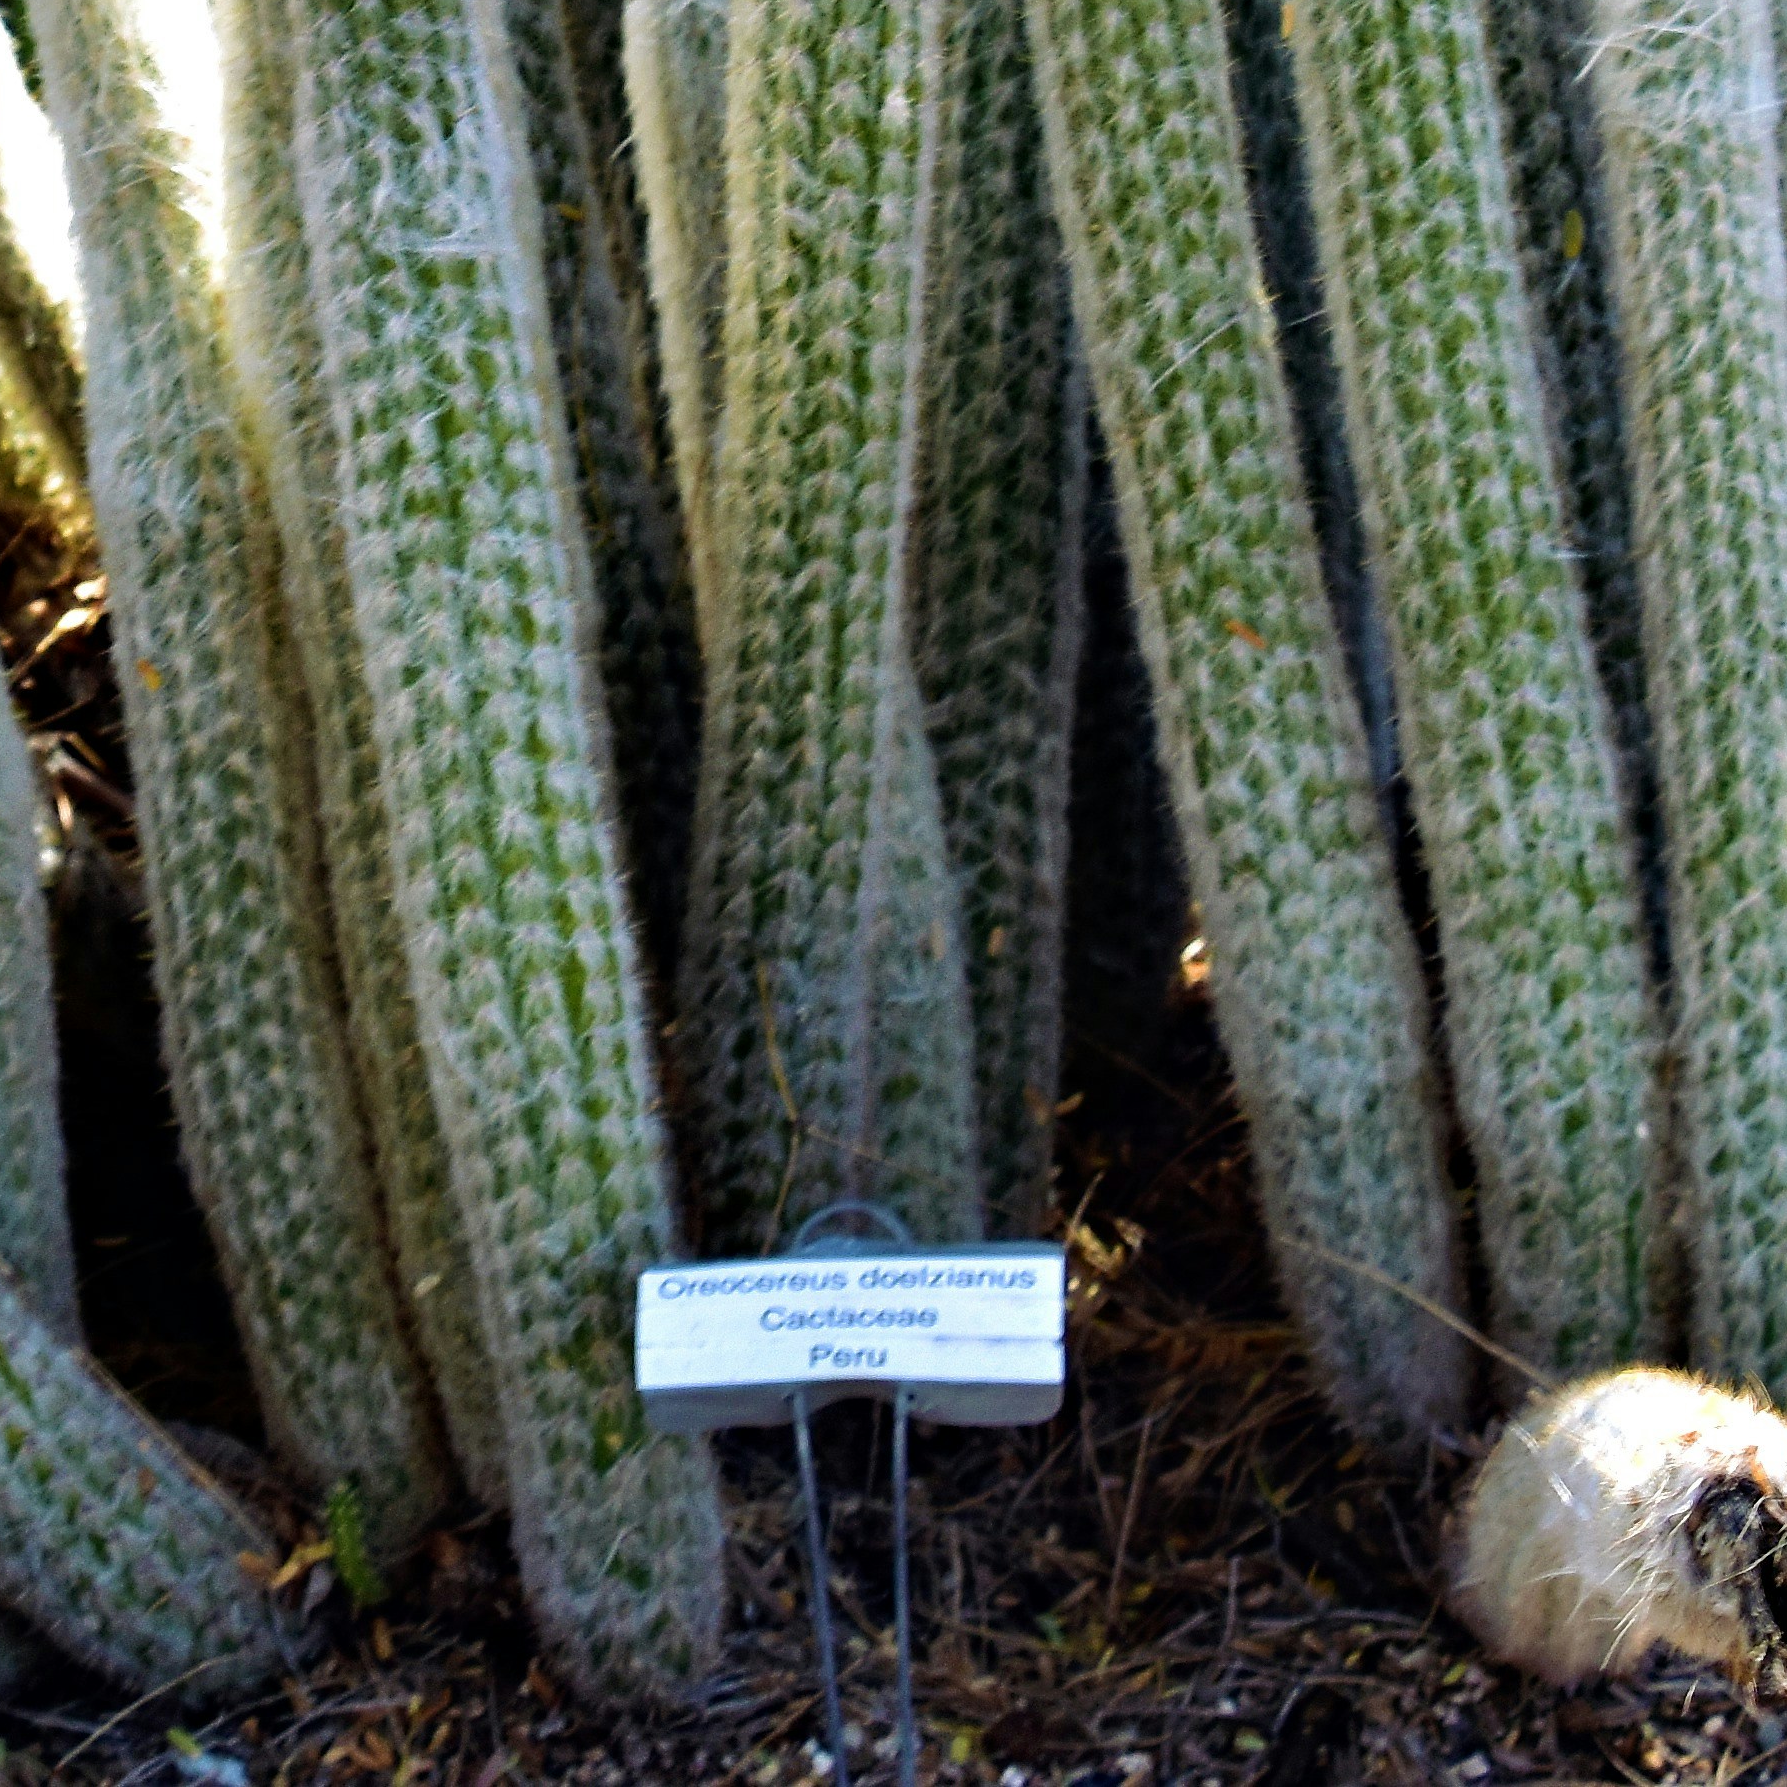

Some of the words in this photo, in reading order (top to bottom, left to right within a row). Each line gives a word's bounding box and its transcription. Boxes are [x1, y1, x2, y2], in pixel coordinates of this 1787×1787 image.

[657, 1267, 848, 1300] Oreocereus
[759, 1305, 939, 1331] Cactaceae
[808, 1343, 889, 1369] Peru
